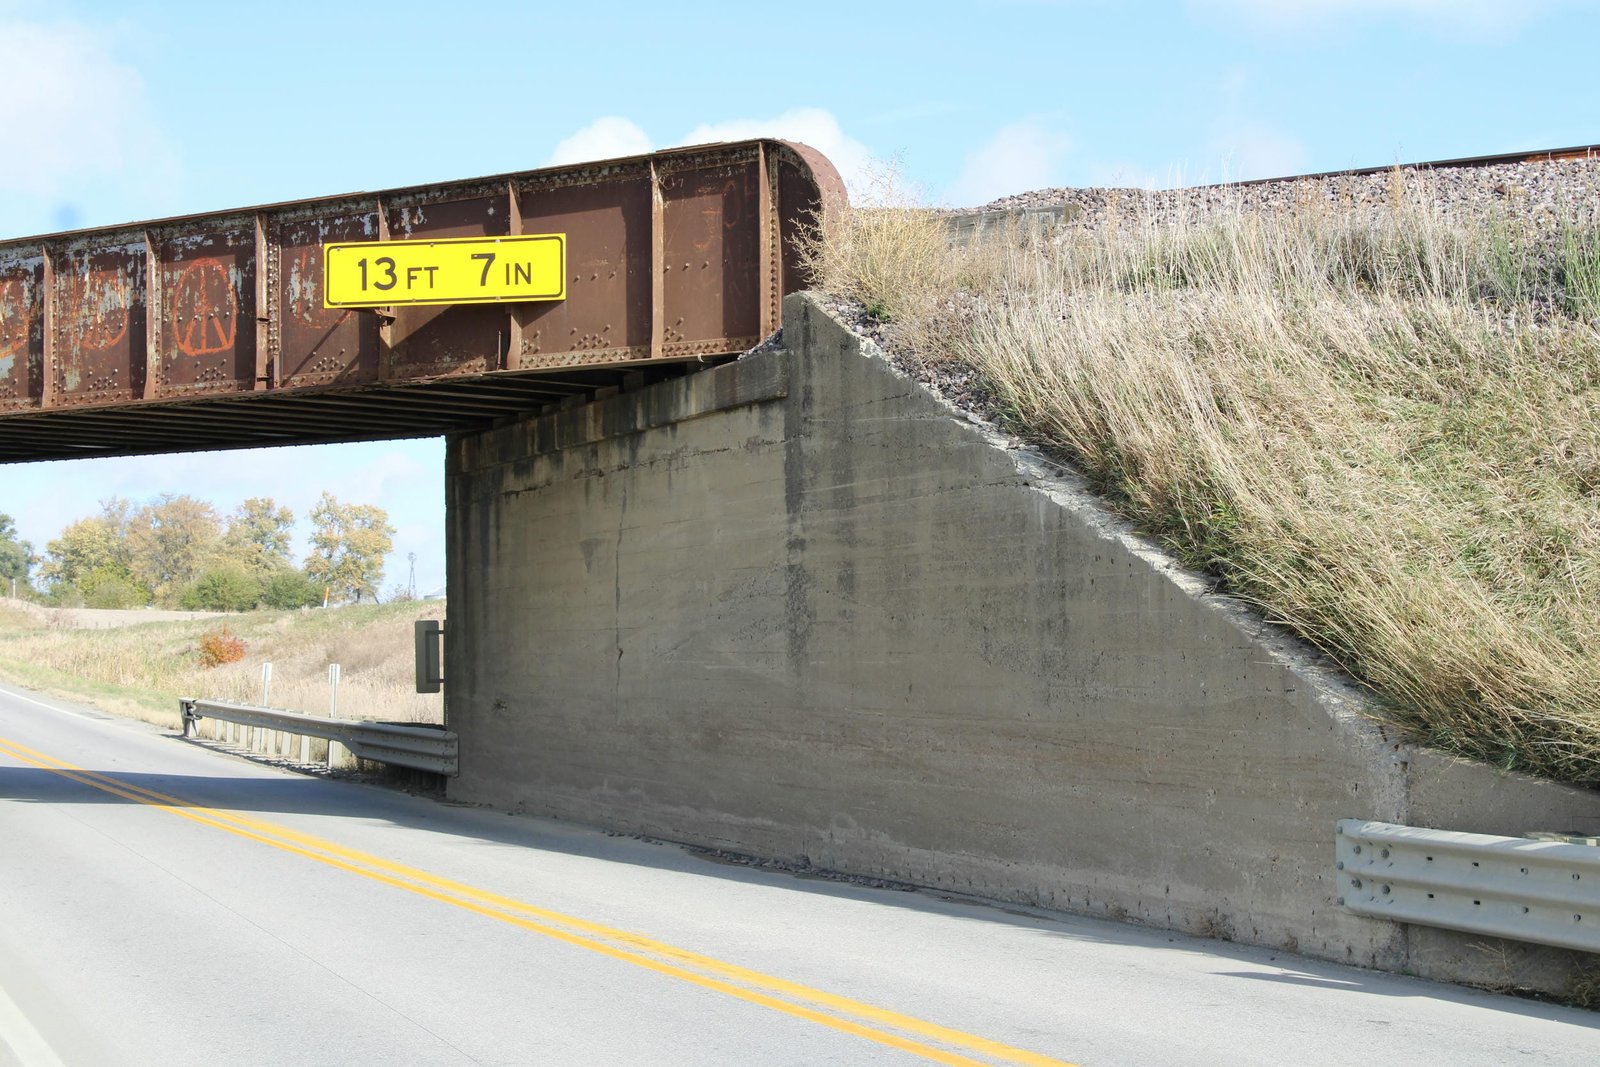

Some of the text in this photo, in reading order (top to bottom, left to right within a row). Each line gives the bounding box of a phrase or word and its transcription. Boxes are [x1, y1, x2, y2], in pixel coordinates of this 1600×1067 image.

[357, 253, 531, 291] 13 FT 7 IN
